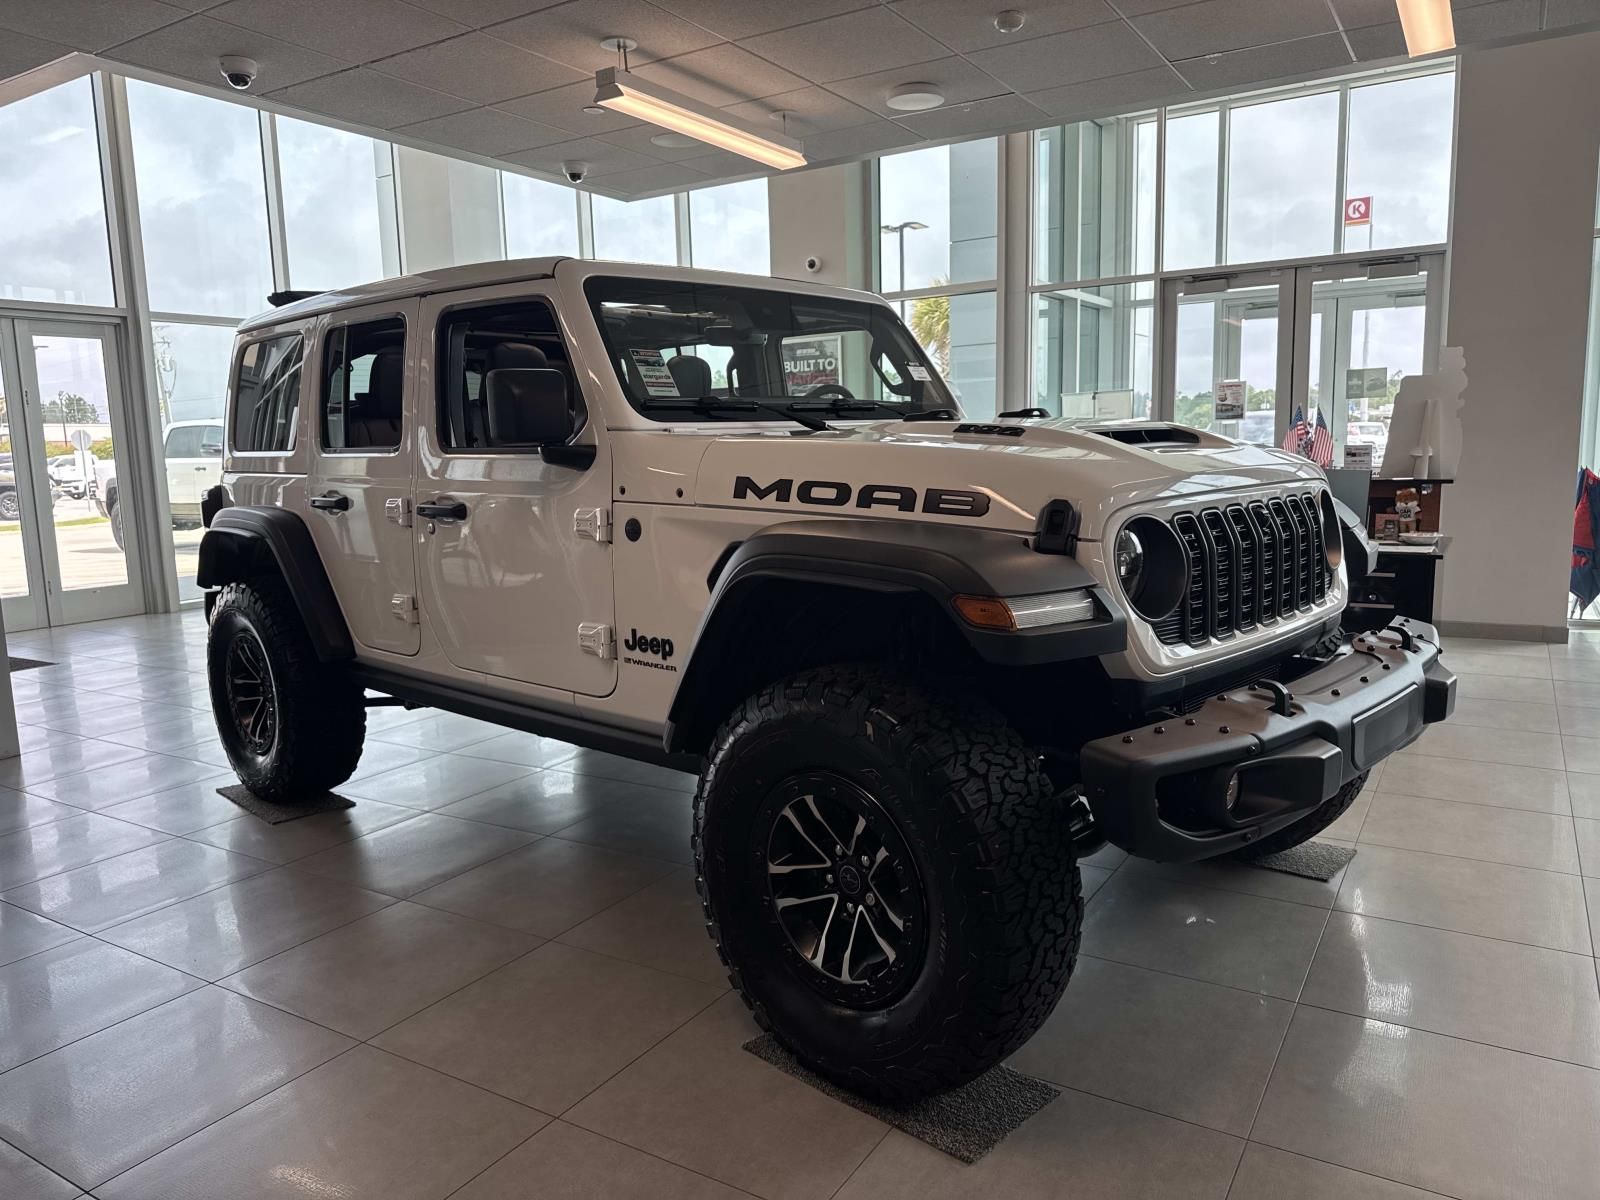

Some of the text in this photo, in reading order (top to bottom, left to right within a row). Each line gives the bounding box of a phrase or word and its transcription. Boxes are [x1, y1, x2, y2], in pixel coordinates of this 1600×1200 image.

[783, 358, 836, 373] BUILT TO
[733, 475, 992, 518] MOAB
[624, 628, 674, 661] Jeep
[631, 658, 678, 672] WRANGLER
